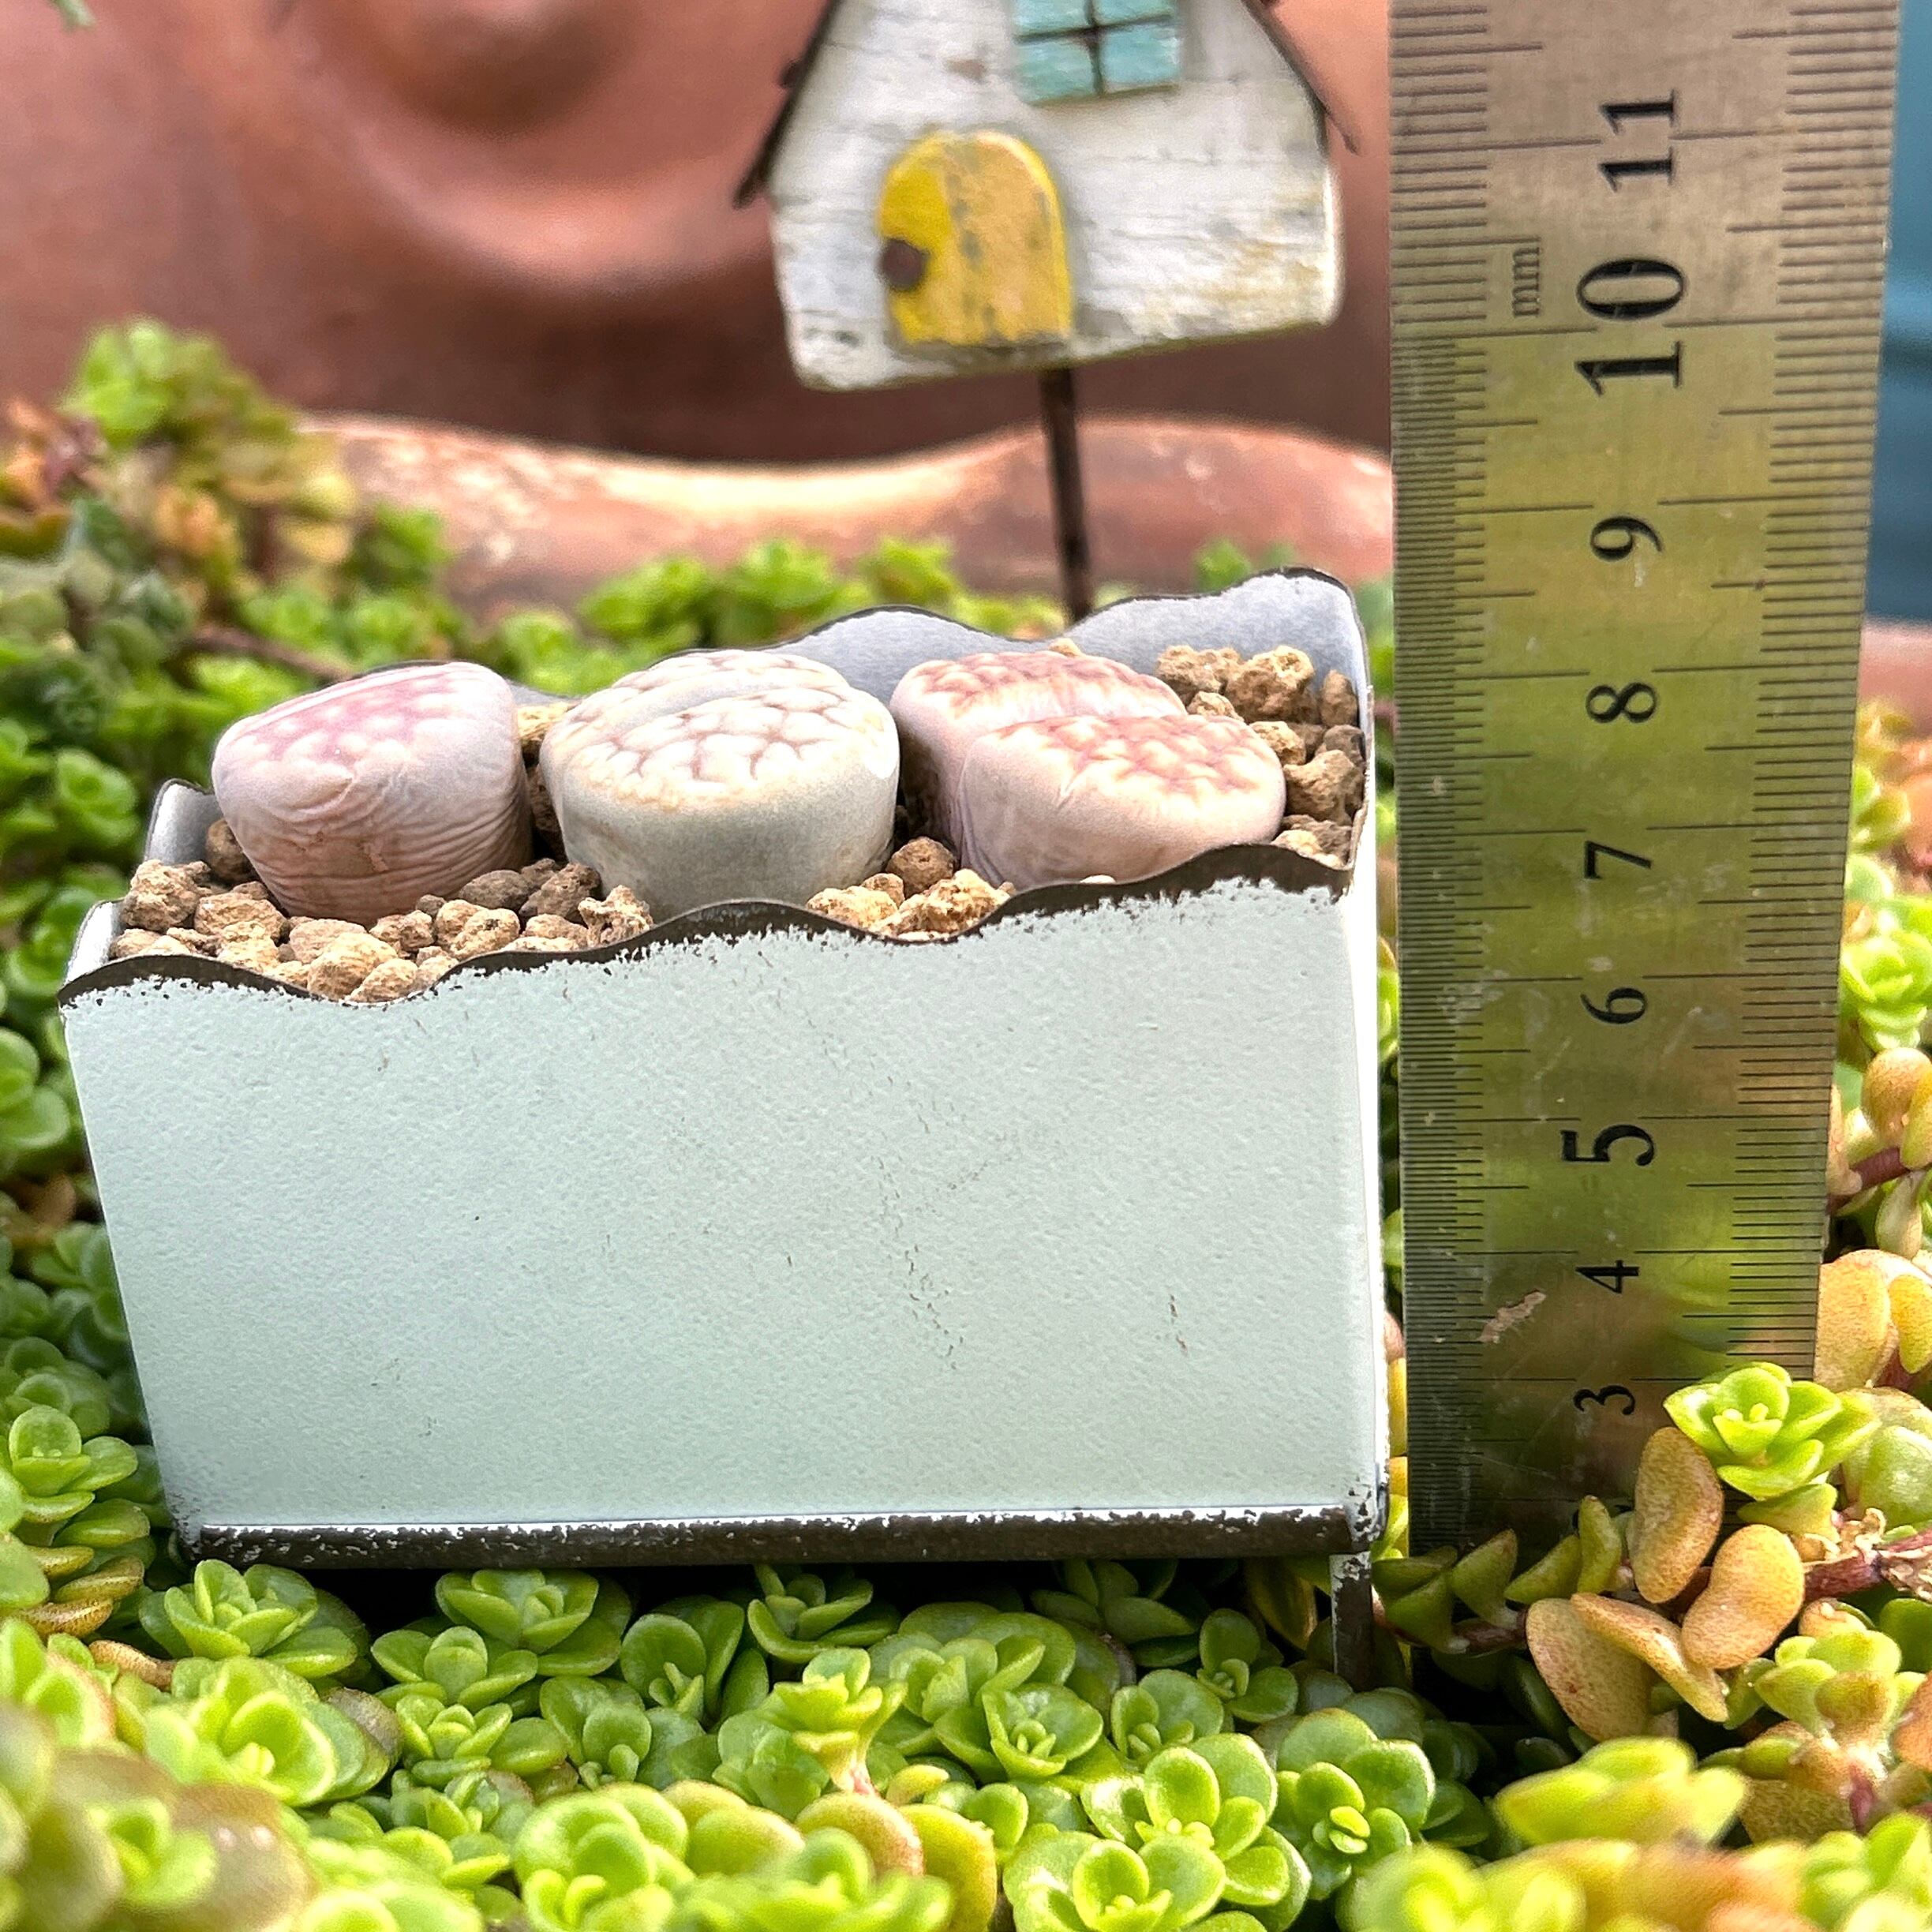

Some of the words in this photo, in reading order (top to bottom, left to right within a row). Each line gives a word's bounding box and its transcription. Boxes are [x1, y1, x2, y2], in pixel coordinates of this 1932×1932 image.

[1599, 88, 1679, 193] 11
[1511, 246, 1541, 317] mm
[1574, 258, 1684, 395] 10
[1589, 515, 1663, 561] 9
[1586, 683, 1657, 723] 8
[1584, 841, 1651, 879] 7
[1580, 987, 1647, 1024] 6
[1560, 1124, 1654, 1166] 5
[1575, 1260, 1639, 1294] 4
[1573, 1384, 1635, 1415] 3
